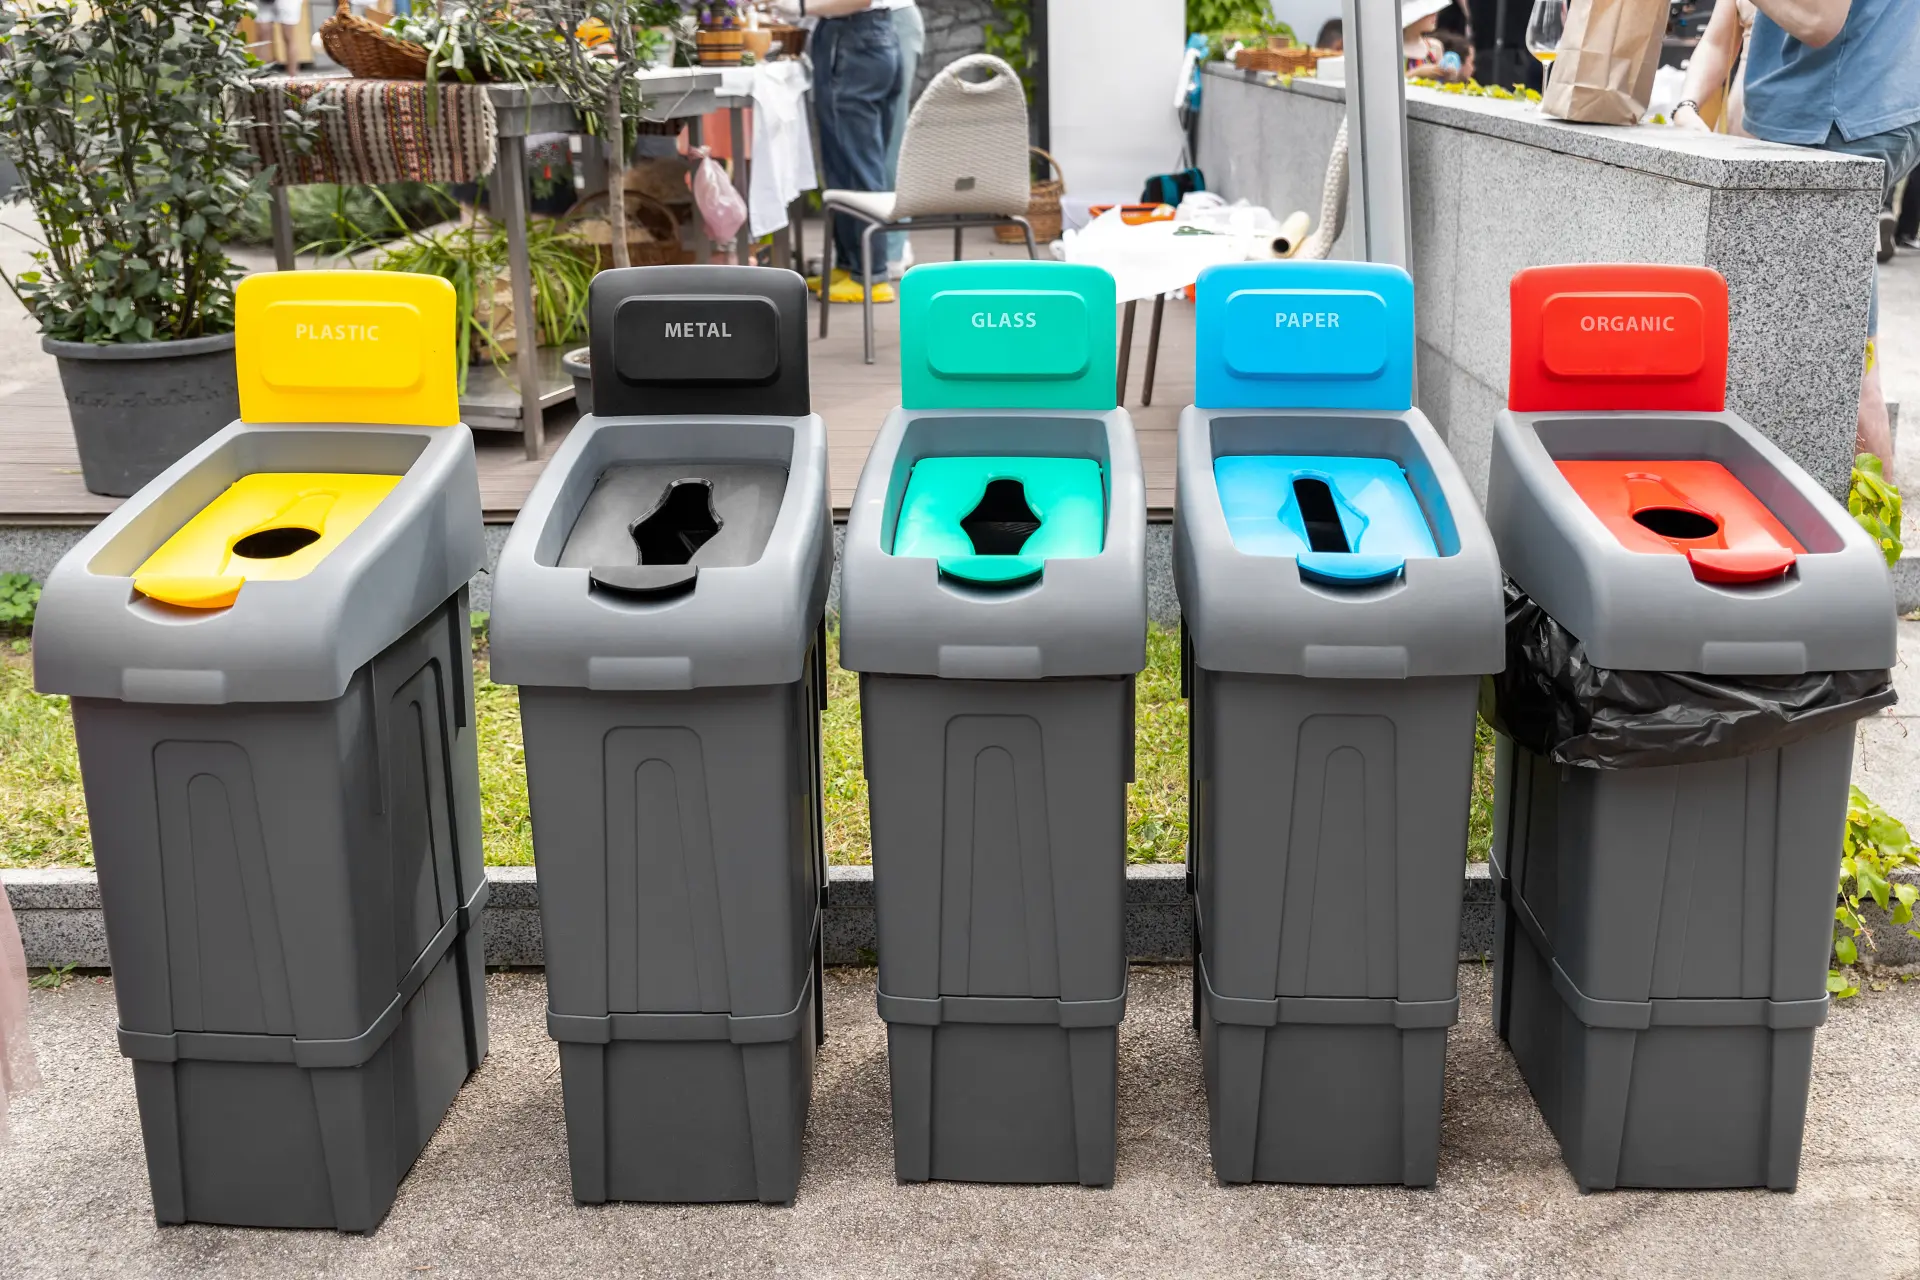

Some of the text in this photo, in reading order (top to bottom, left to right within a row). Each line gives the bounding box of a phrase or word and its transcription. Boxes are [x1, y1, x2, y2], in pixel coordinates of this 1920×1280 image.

[971, 312, 1037, 329] GLASS
[1275, 312, 1340, 328] PAPER
[1580, 315, 1675, 332] ORGANIC
[295, 323, 379, 341] PLASTIC
[664, 322, 732, 338] METAL
